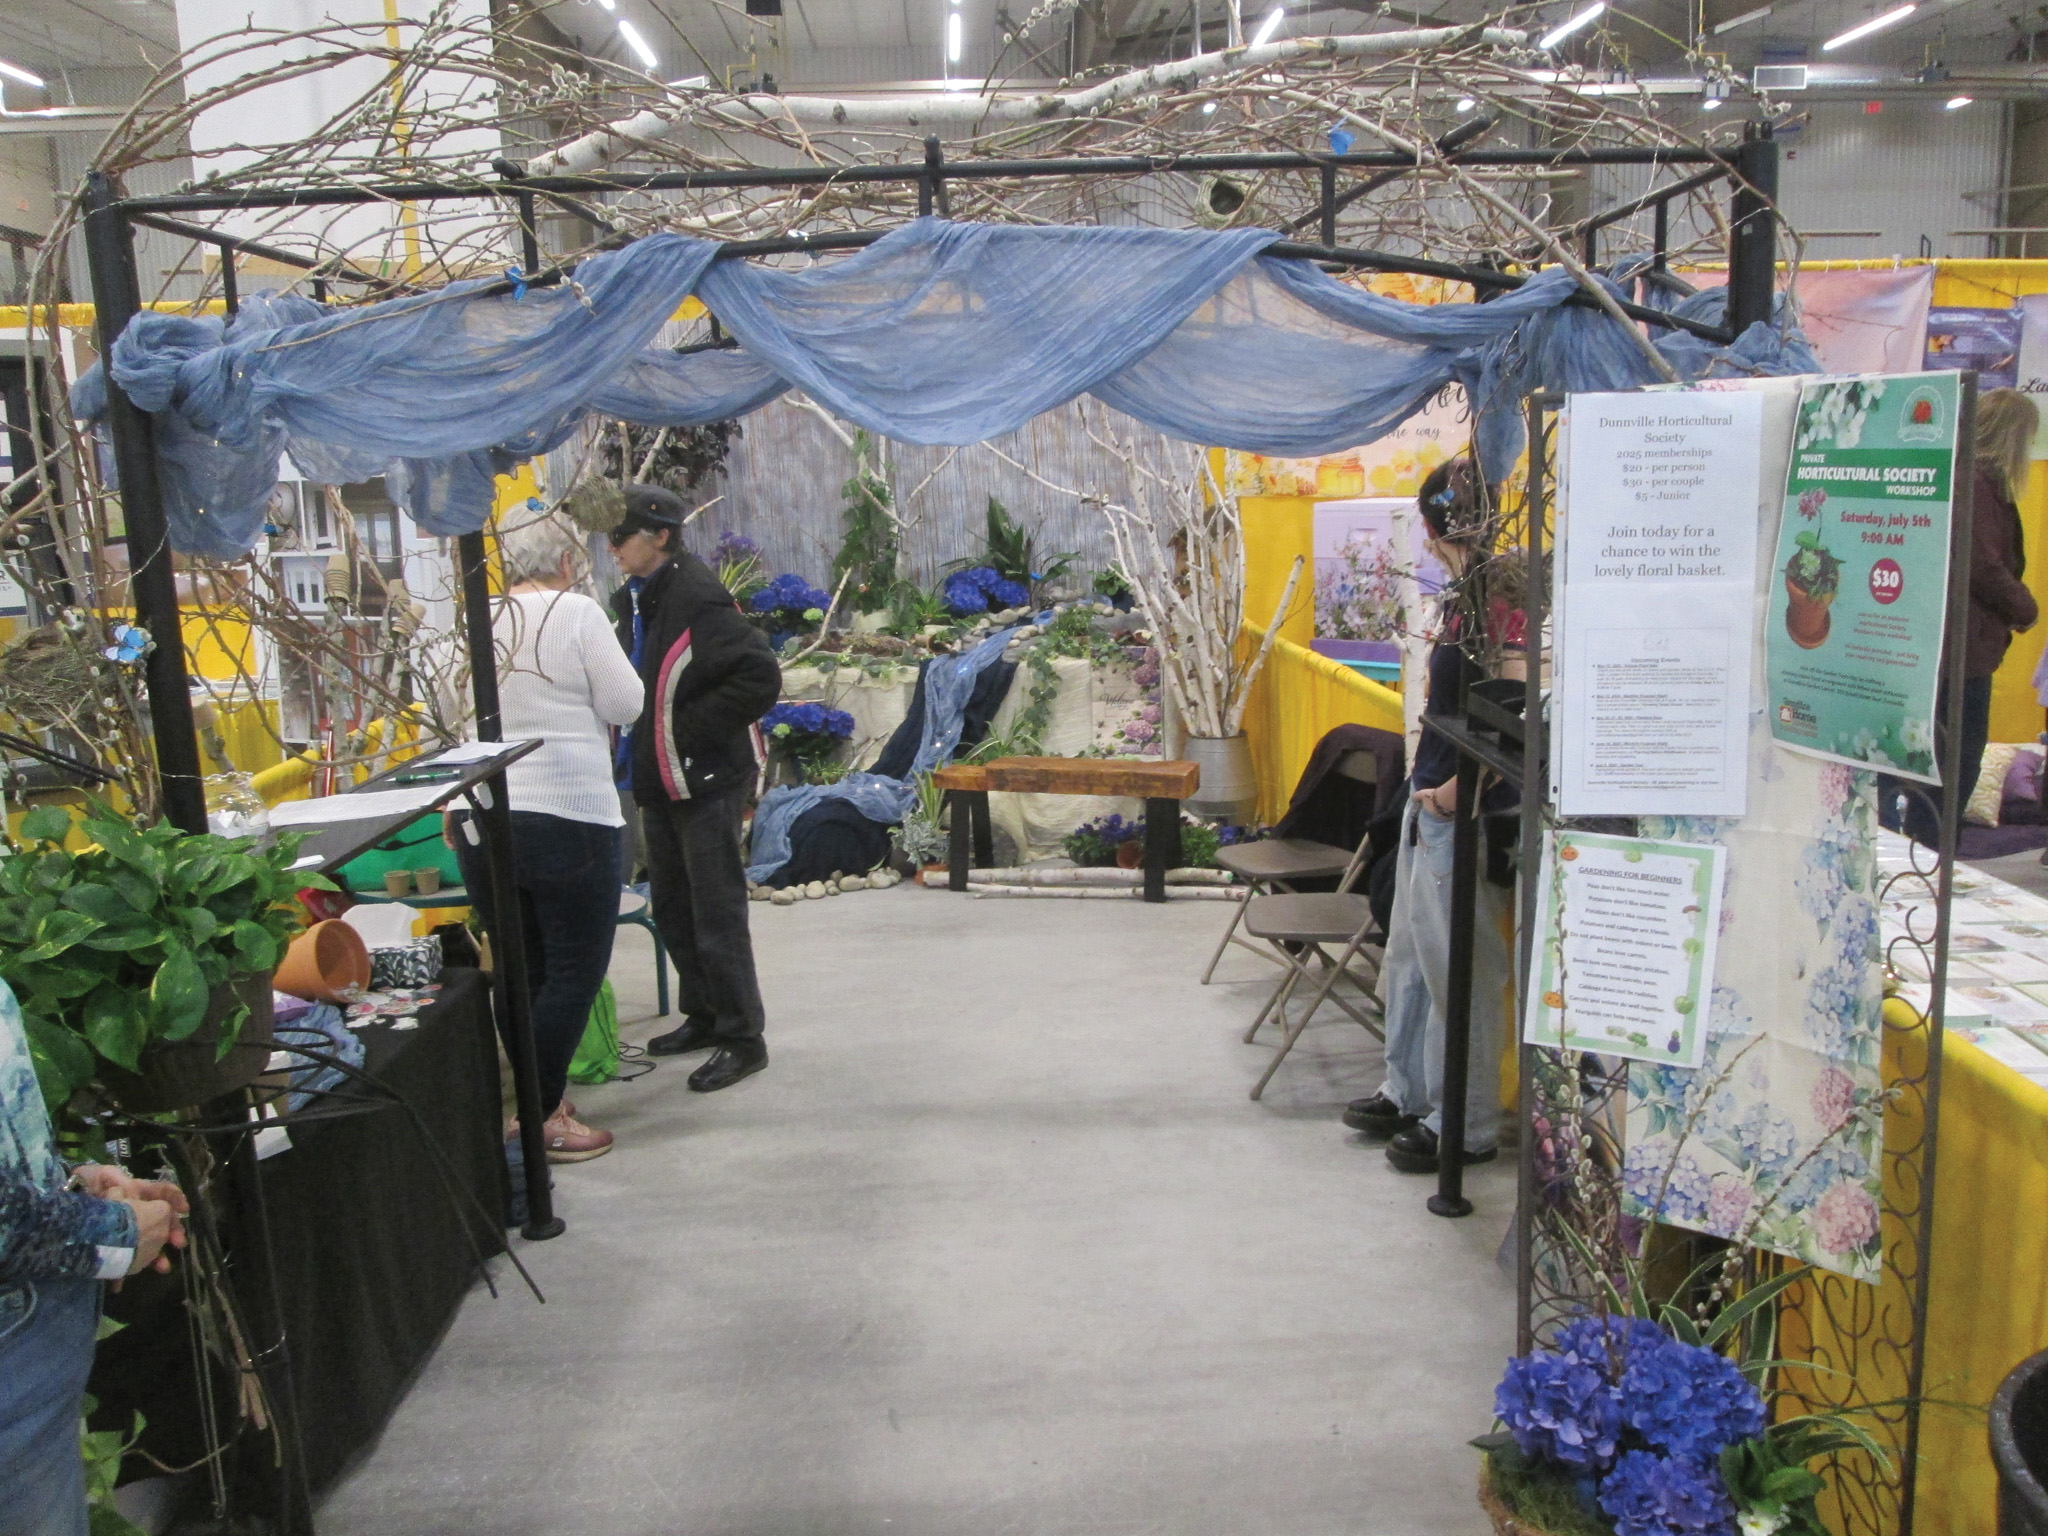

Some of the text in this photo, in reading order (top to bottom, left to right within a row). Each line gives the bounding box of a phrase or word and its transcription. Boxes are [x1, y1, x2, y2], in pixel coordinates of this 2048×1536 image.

[1599, 415, 1733, 427] Dunnville Horticultural
[1416, 427, 1440, 440] way
[1644, 433, 1686, 443] Society
[1617, 448, 1713, 459] 2025 memberships
[1800, 454, 1825, 463] PRIVATE
[1623, 464, 1643, 473] $20
[1652, 465, 1669, 474] per
[1671, 463, 1705, 473] person
[1797, 467, 1937, 483] HORTICULTURAL SOCIETY
[1623, 478, 1643, 488] $30
[1652, 479, 1669, 488] per
[1671, 477, 1704, 487] couple
[1635, 492, 1648, 502] $5
[1656, 491, 1691, 501] Junior
[1886, 485, 1937, 496] WORKSHOP
[1840, 511, 1885, 527] Saturday,
[1912, 515, 1930, 527] 5th
[1608, 525, 1715, 540] Join today for a
[1861, 532, 1905, 545] 9:00 AM
[1601, 544, 1721, 557] chance to win the
[1594, 564, 1726, 579] lovely floral basket.
[1872, 568, 1900, 588] $30
[1579, 867, 1683, 884] GARDENING FOR BEGINNERS
